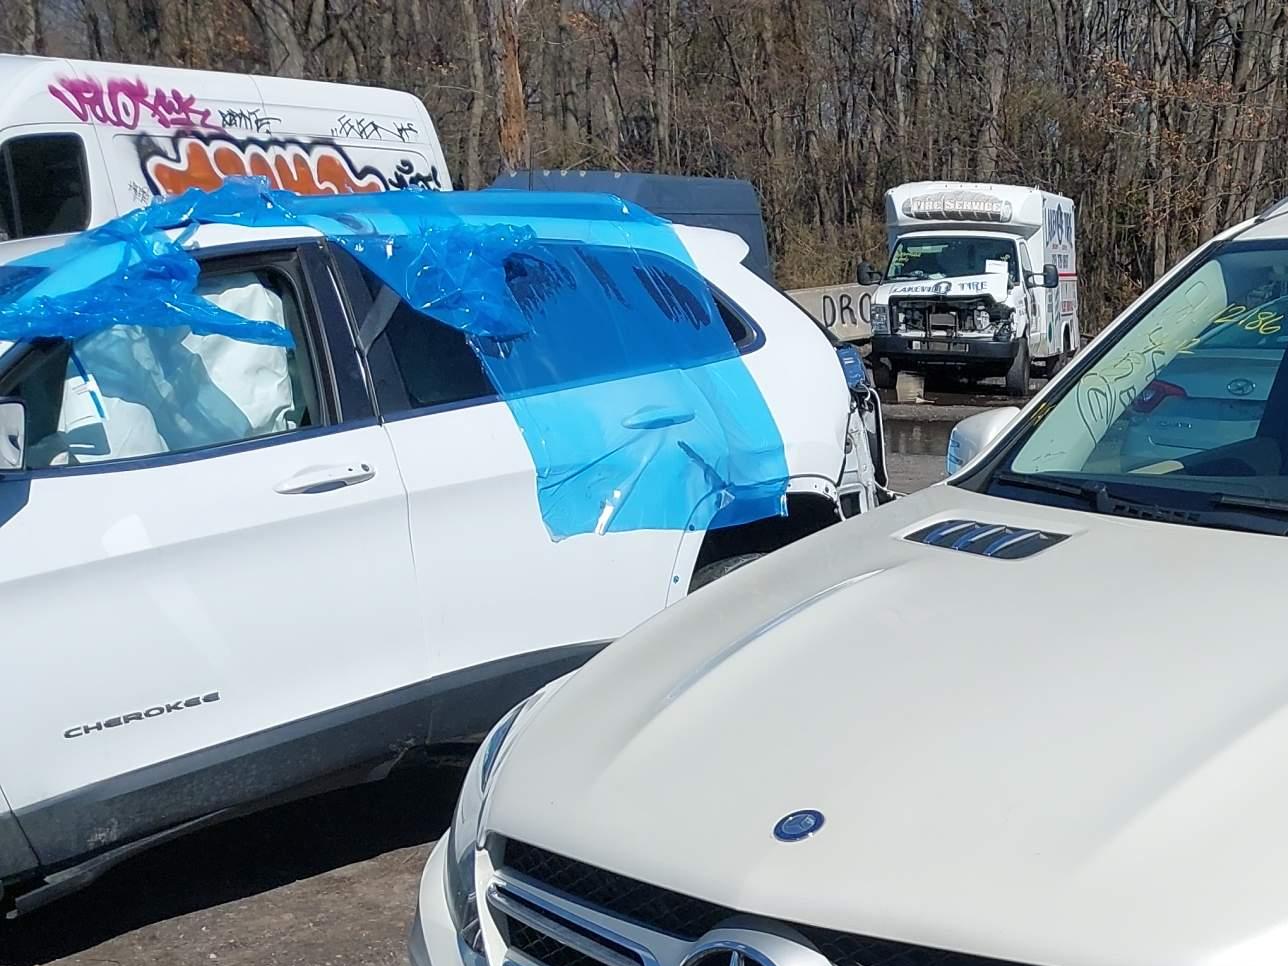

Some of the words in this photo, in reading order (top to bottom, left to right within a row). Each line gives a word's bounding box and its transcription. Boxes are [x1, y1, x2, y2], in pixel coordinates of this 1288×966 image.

[912, 199, 941, 211] TIRE
[944, 199, 1001, 212] SERVICE
[959, 281, 989, 293] TIRE
[64, 691, 221, 739] CHEROKEE
